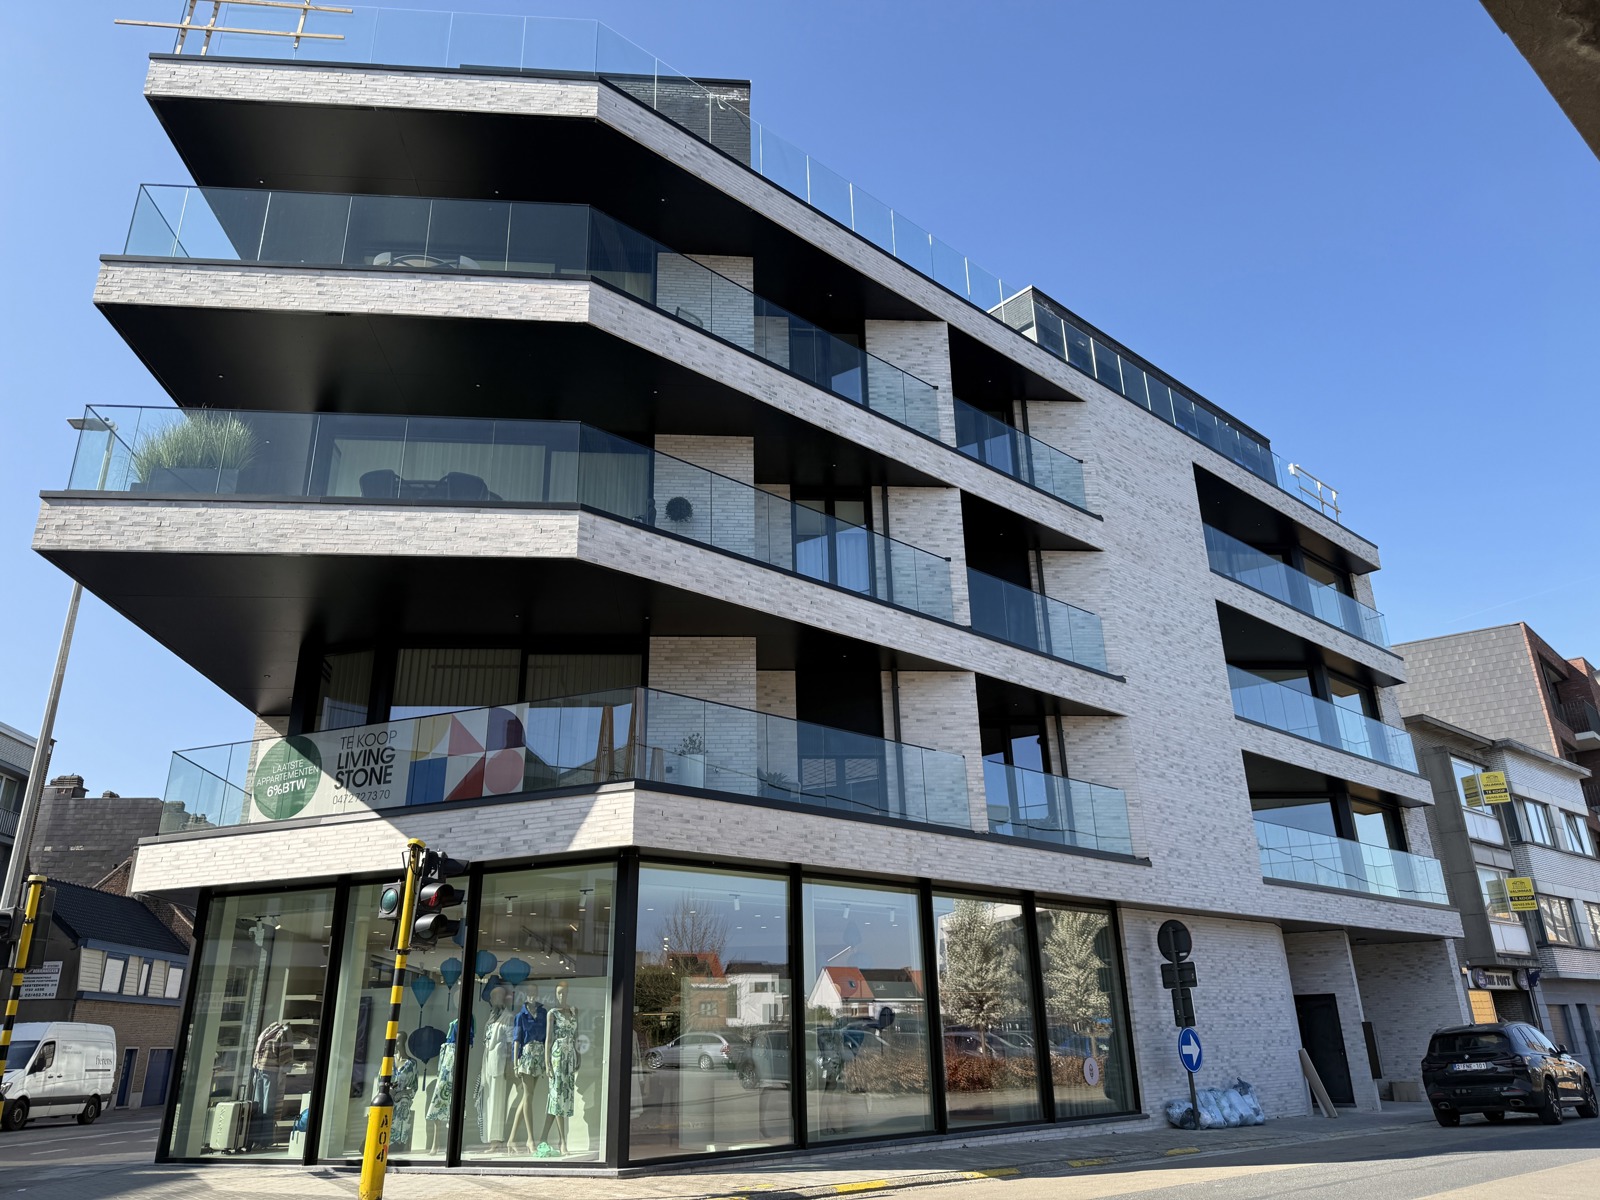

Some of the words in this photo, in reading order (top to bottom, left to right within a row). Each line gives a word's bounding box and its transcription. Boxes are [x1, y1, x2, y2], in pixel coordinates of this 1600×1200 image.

[341, 736, 354, 750] TE
[357, 730, 397, 747] KOOP
[272, 759, 304, 774] LAATSTE
[337, 746, 396, 770] LIVING
[256, 765, 320, 787] APPARTEMENTEN
[334, 765, 393, 790] STONE
